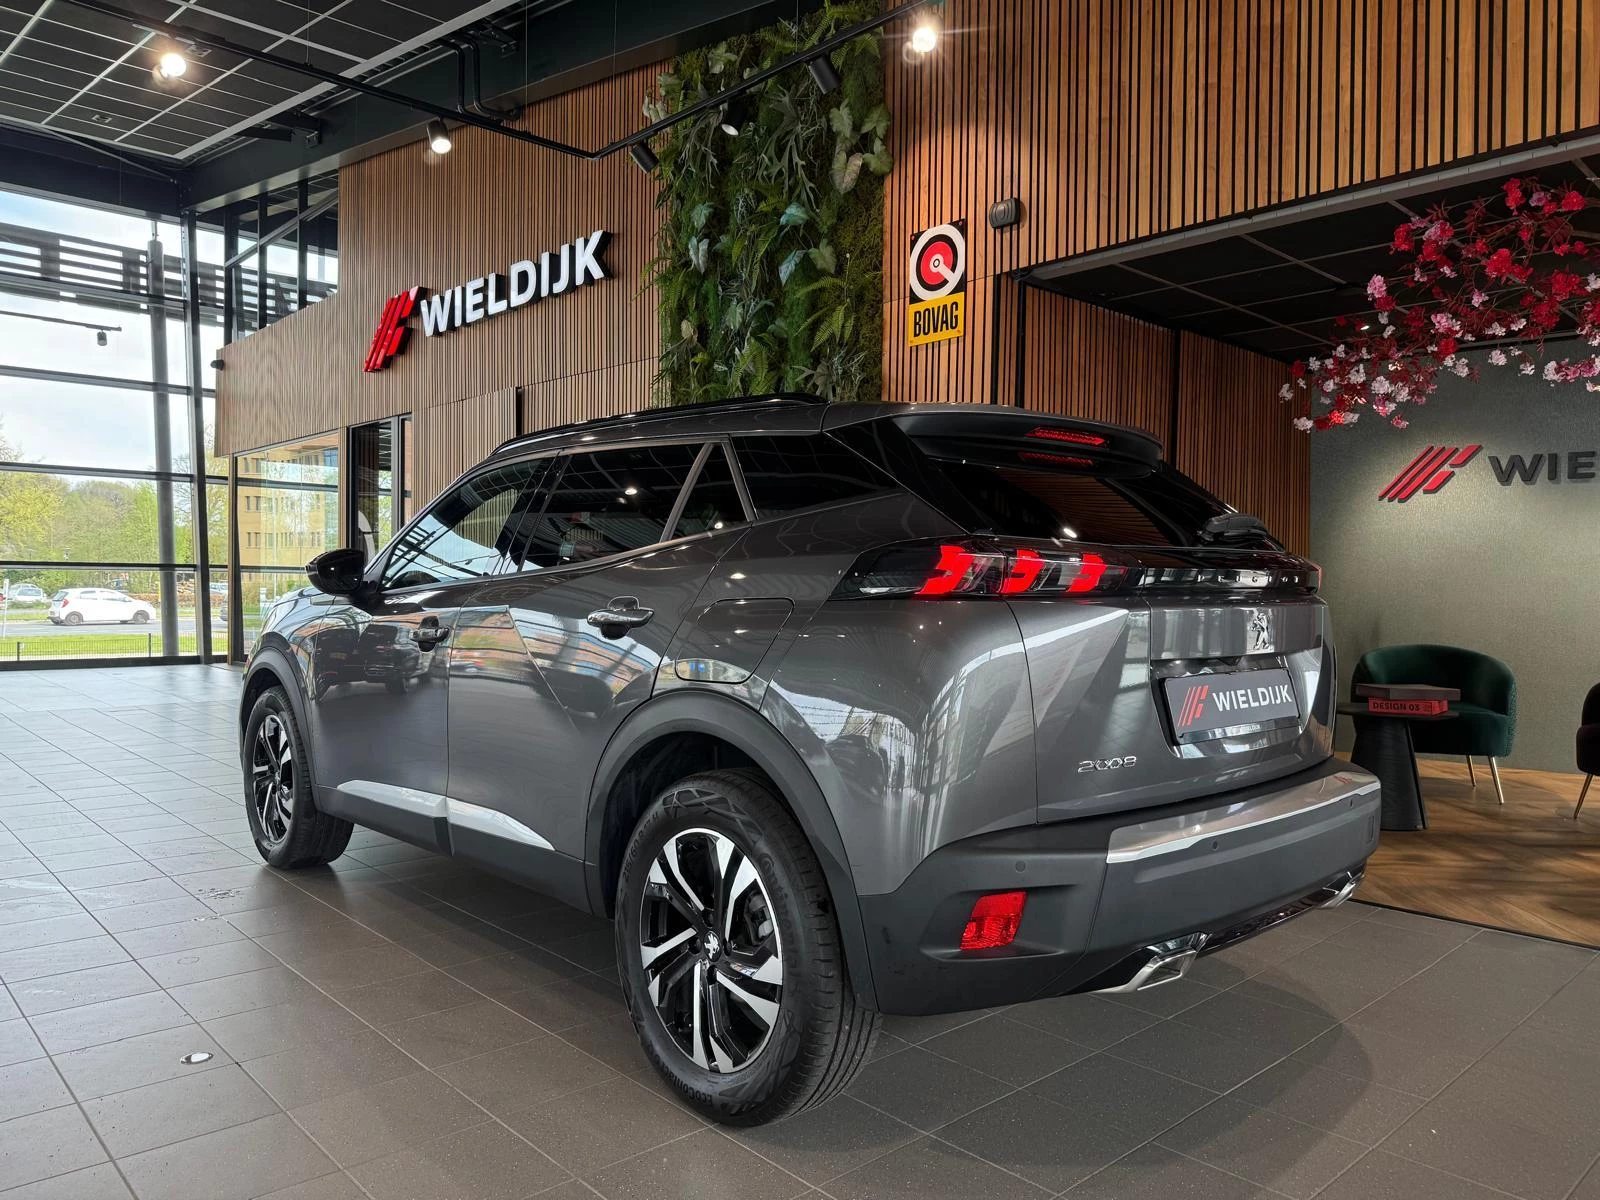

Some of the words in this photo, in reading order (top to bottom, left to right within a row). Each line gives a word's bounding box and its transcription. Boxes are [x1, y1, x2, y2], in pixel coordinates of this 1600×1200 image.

[420, 229, 607, 337] WIELDIJK
[913, 301, 959, 338] BOVAG
[1488, 450, 1596, 486] WIE
[1212, 684, 1293, 712] WIELDIJK
[1372, 702, 1407, 711] DESIGN
[1077, 755, 1137, 773] 2008
